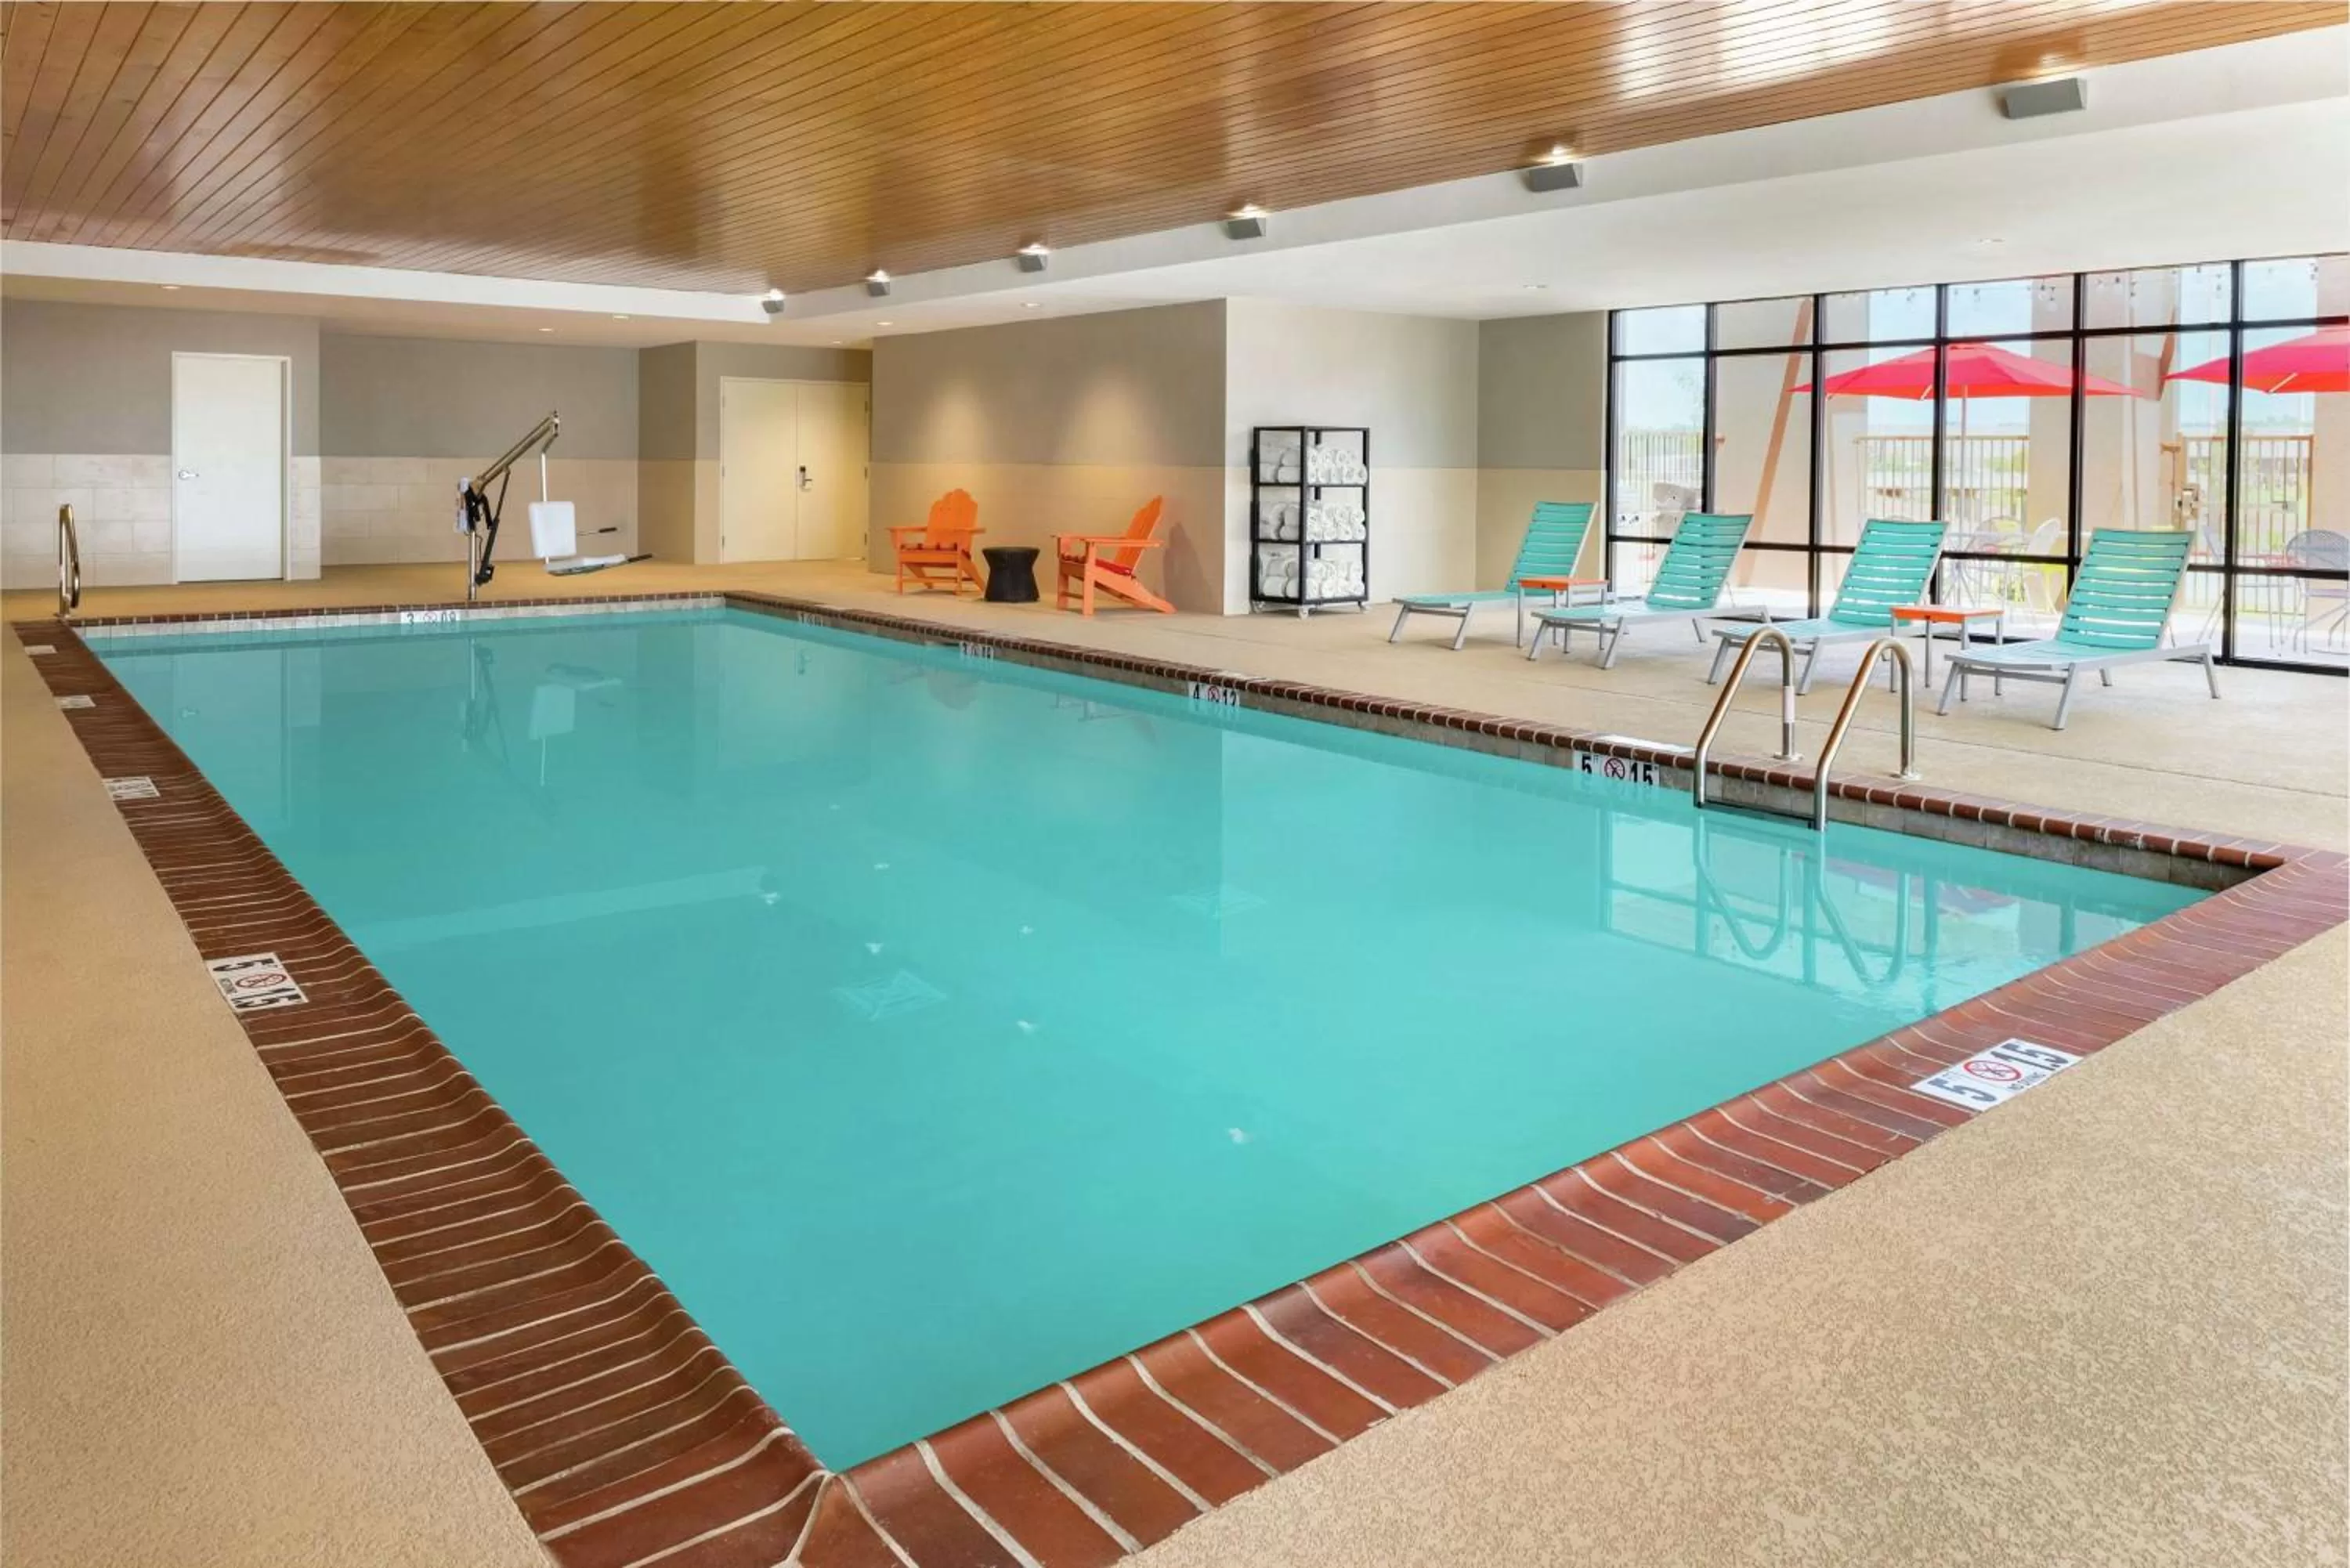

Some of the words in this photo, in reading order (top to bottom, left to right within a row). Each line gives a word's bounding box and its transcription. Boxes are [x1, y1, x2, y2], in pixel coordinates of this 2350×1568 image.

[1582, 754, 1592, 775] 5
[212, 958, 275, 972] 5
[1927, 1077, 1998, 1102] 5
